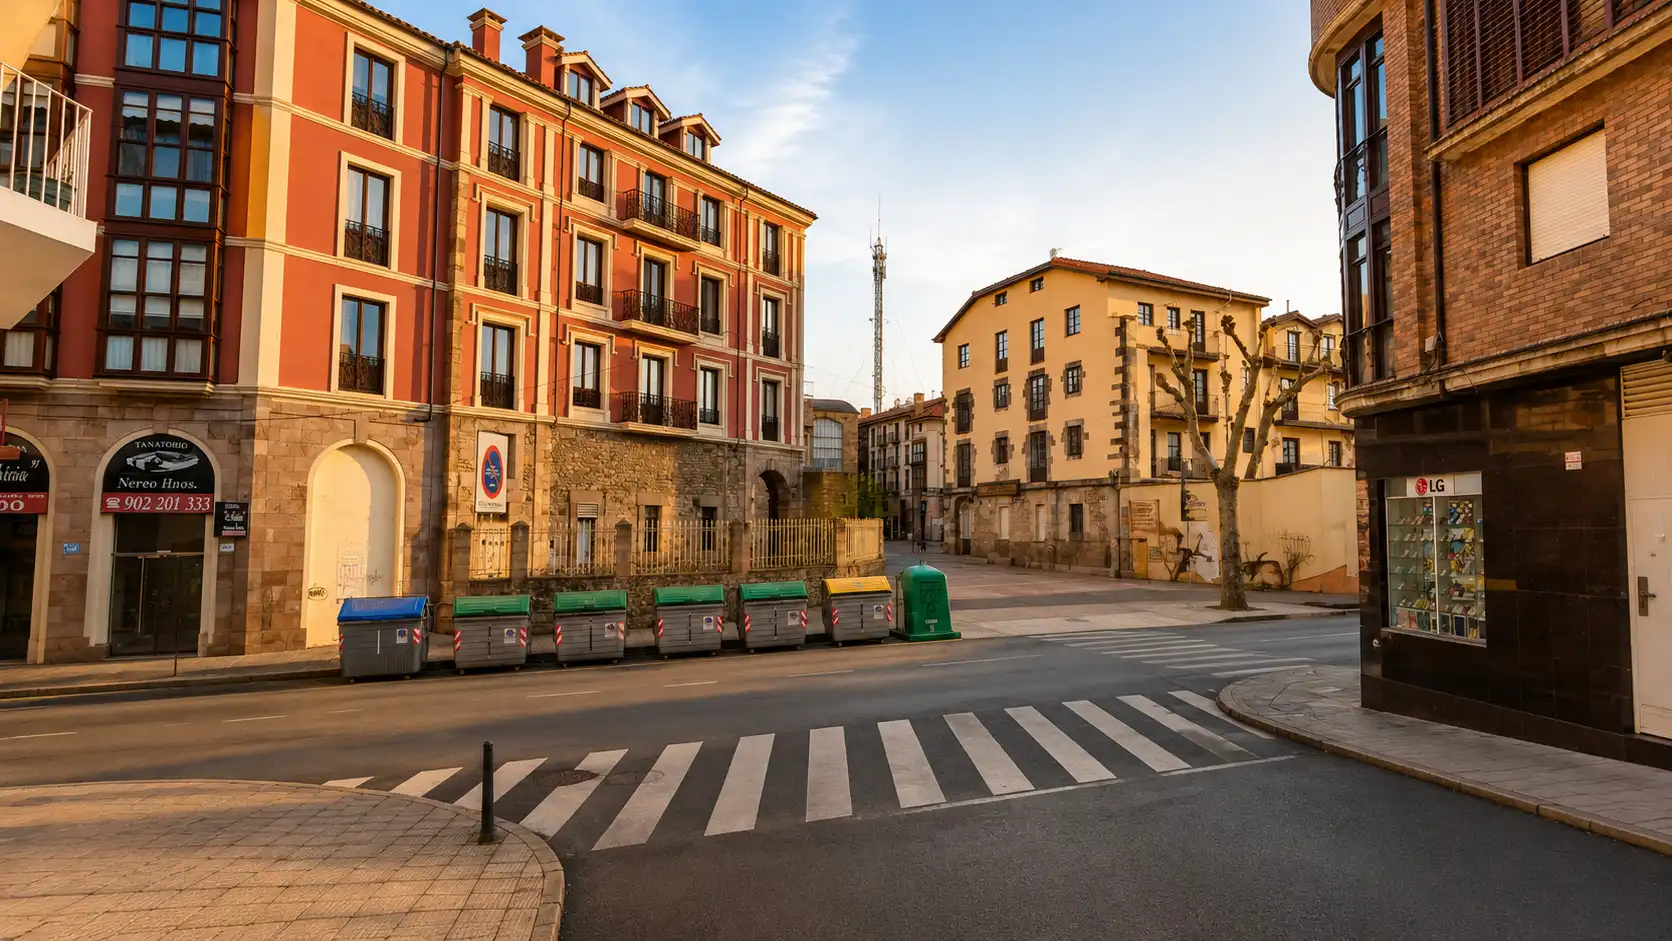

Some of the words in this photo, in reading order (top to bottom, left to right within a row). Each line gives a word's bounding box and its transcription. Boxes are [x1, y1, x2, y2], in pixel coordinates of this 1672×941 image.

[135, 441, 188, 450] TANATORIO
[117, 477, 158, 489] Nereo
[161, 478, 198, 490] Hnos.
[1429, 478, 1445, 493] LG
[123, 496, 152, 511] 902
[155, 496, 181, 511] 201
[184, 497, 211, 511] 333
